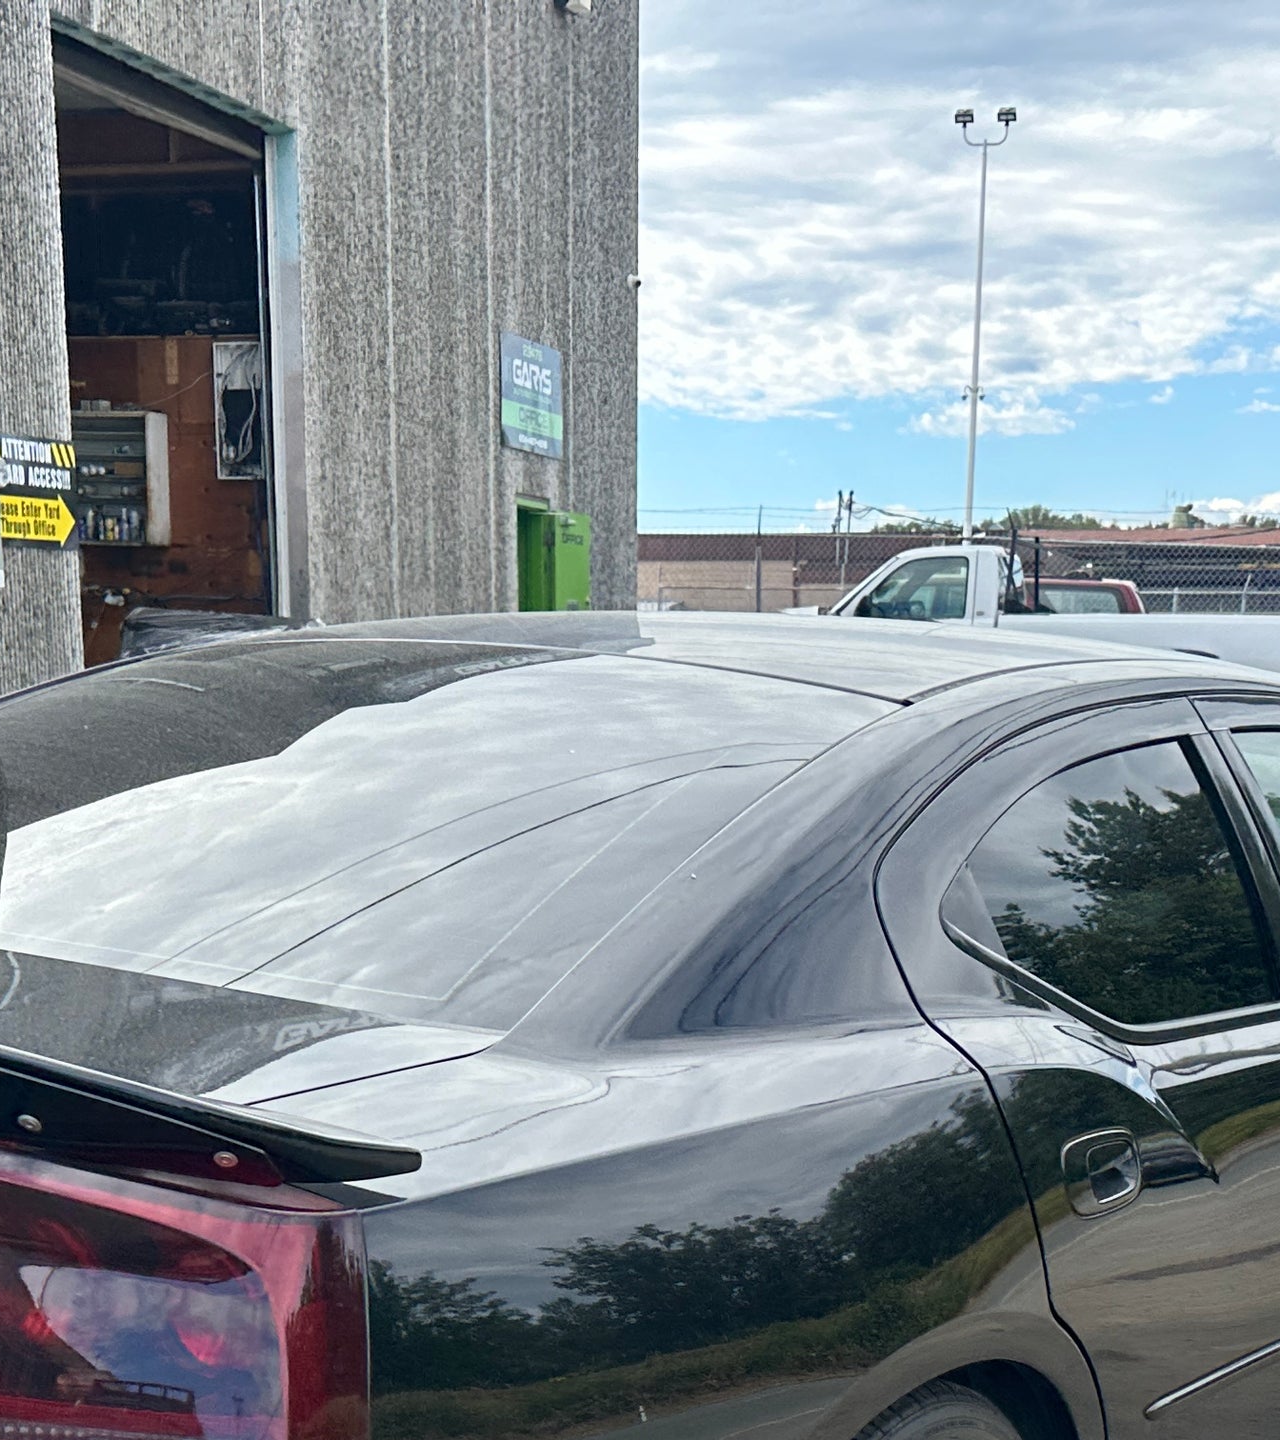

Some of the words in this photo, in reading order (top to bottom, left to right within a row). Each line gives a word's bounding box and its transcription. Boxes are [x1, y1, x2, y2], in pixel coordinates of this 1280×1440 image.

[1, 437, 52, 464] ATTENTION
[6, 464, 25, 486] ARD
[0, 502, 19, 516] ease
[21, 501, 41, 519] Enter
[44, 503, 60, 520] Yard
[1, 518, 31, 538] Through
[33, 520, 56, 537] Office
